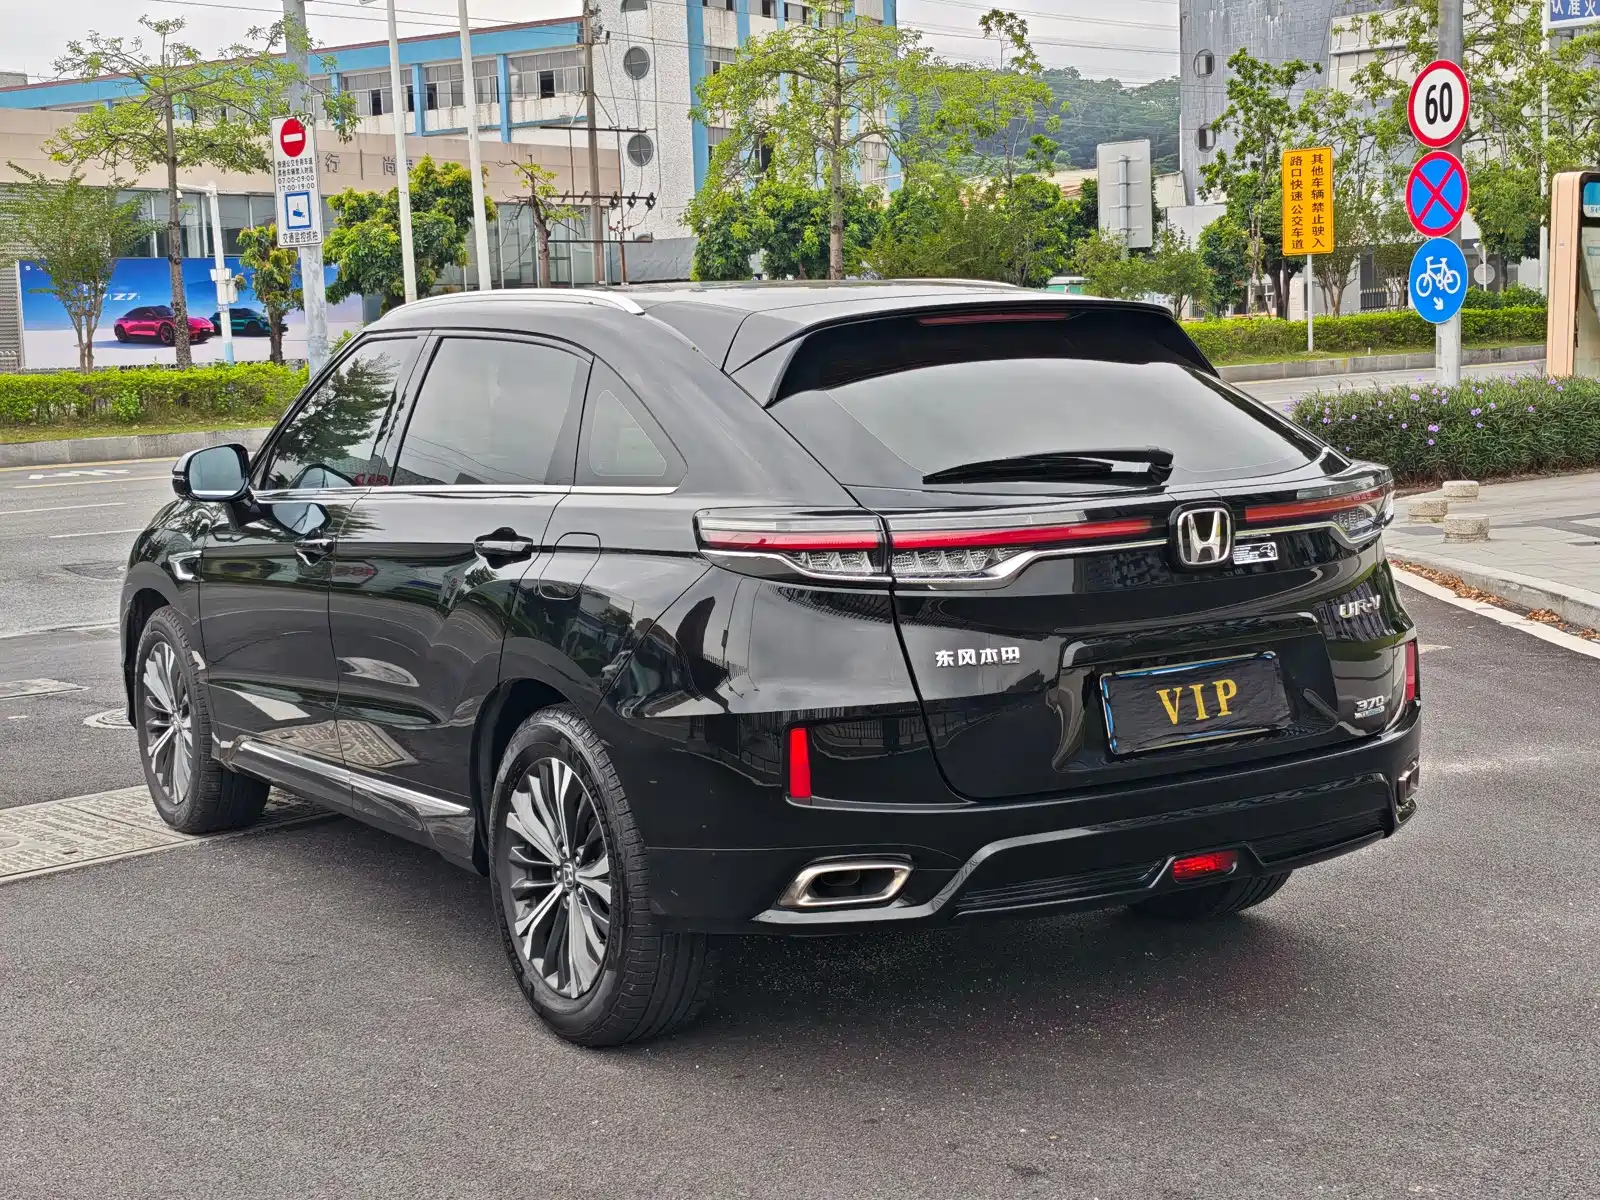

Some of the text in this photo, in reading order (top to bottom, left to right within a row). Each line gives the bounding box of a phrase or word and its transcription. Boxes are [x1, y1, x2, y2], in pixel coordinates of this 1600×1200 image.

[1425, 82, 1453, 125] 60
[1290, 156, 1304, 249] 路口快速公交车道
[1311, 154, 1325, 248] 其他车辆禁止驶入
[1340, 595, 1380, 619] UR-V
[935, 647, 1020, 667] 东风本田
[1156, 679, 1237, 725] VIP
[1356, 695, 1384, 712] 370
